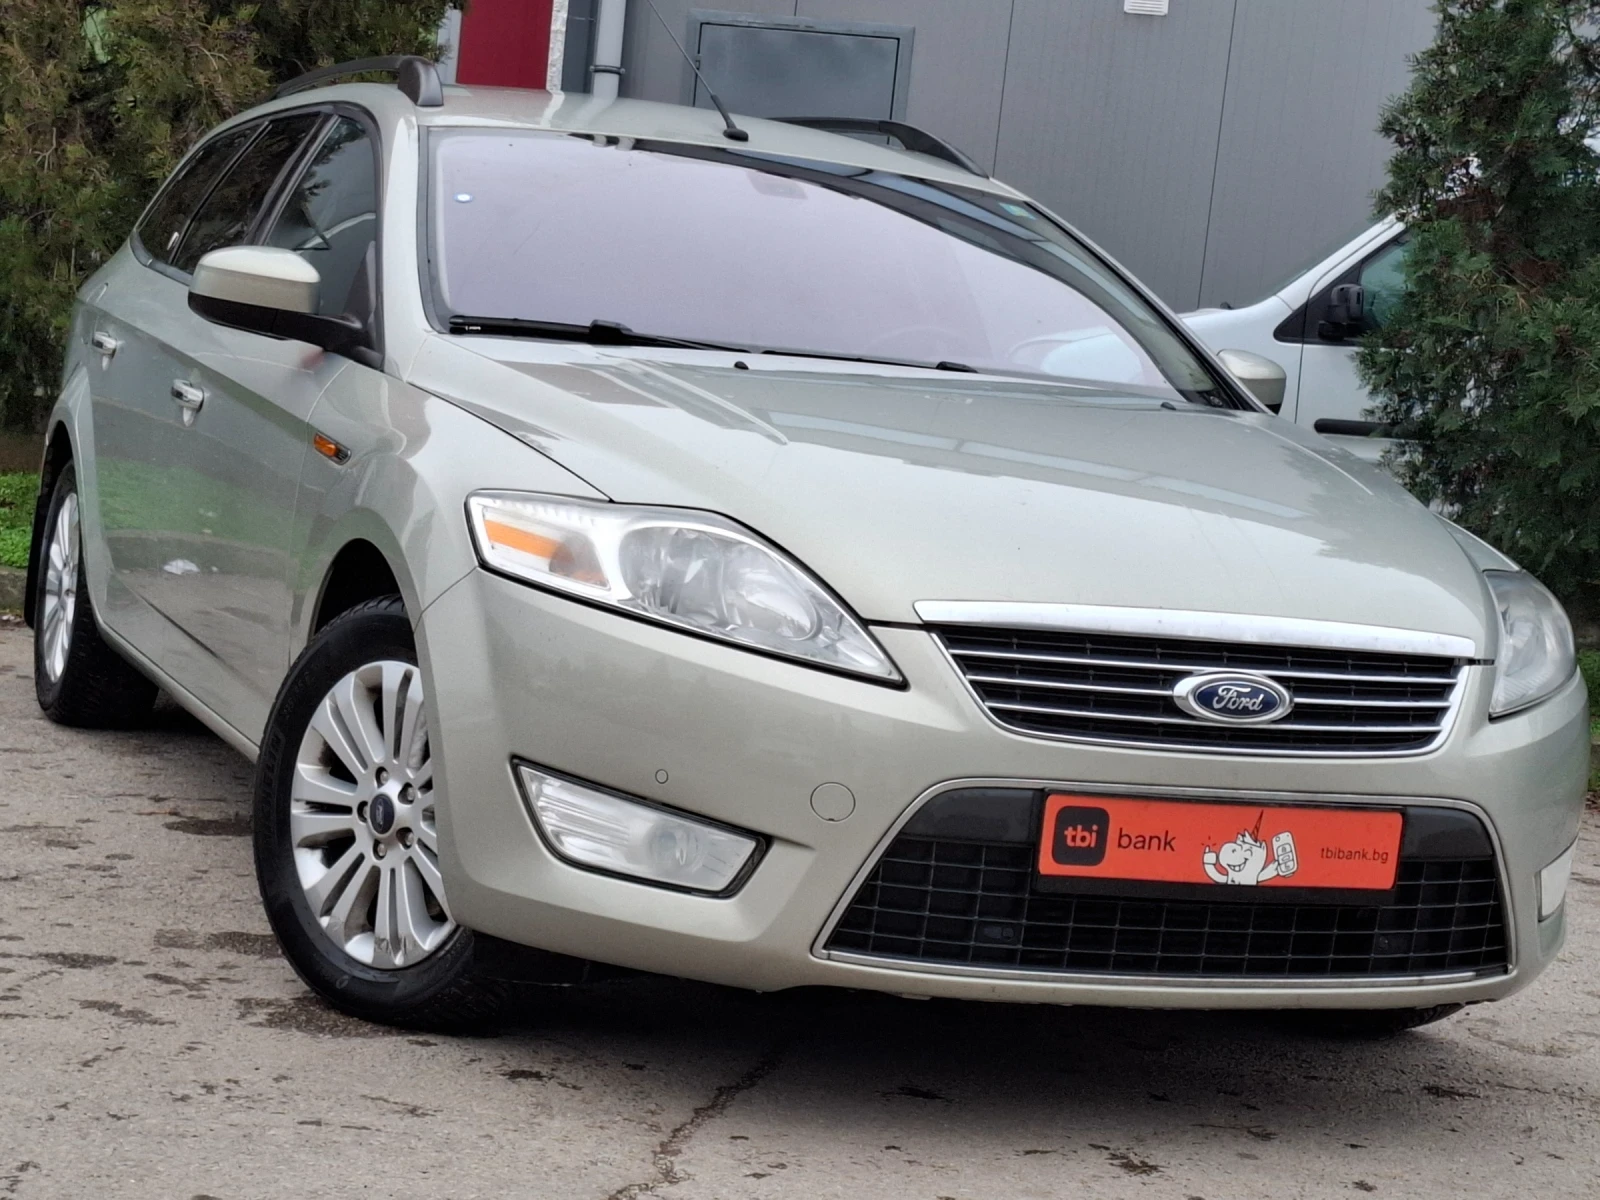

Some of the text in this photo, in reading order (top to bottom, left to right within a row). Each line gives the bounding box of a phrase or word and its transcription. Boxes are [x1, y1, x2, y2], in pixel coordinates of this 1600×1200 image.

[1212, 685, 1264, 710] Ford
[1064, 824, 1176, 852] tbi bank
[1320, 846, 1389, 864] tbibank.bg
